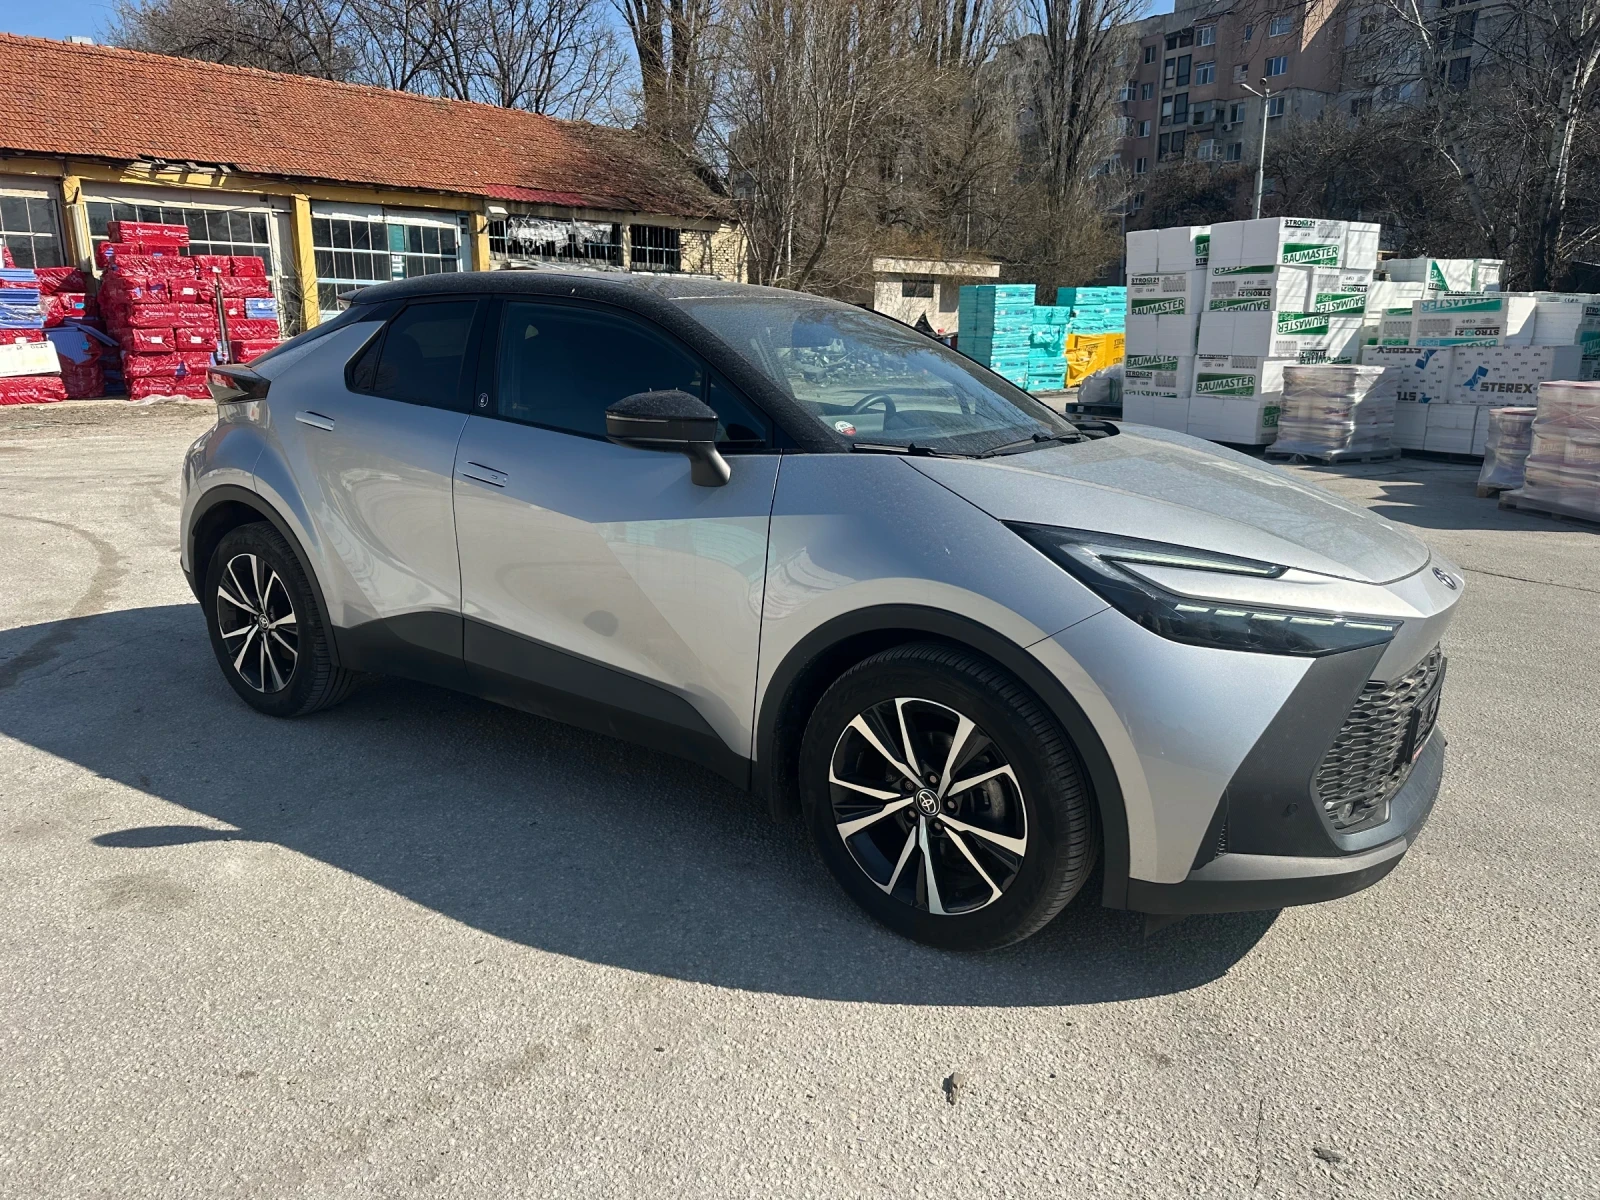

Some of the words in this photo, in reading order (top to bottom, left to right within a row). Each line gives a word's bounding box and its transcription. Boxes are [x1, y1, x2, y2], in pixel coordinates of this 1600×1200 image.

[1283, 246, 1338, 264] BAUMASTER
[1132, 300, 1184, 315] BAUMASTER
[1316, 296, 1366, 313] BAUMASTER
[1278, 314, 1329, 333] BAUMASTER
[1197, 376, 1254, 392] BAUMASTER
[1480, 382, 1534, 394] STEREX
